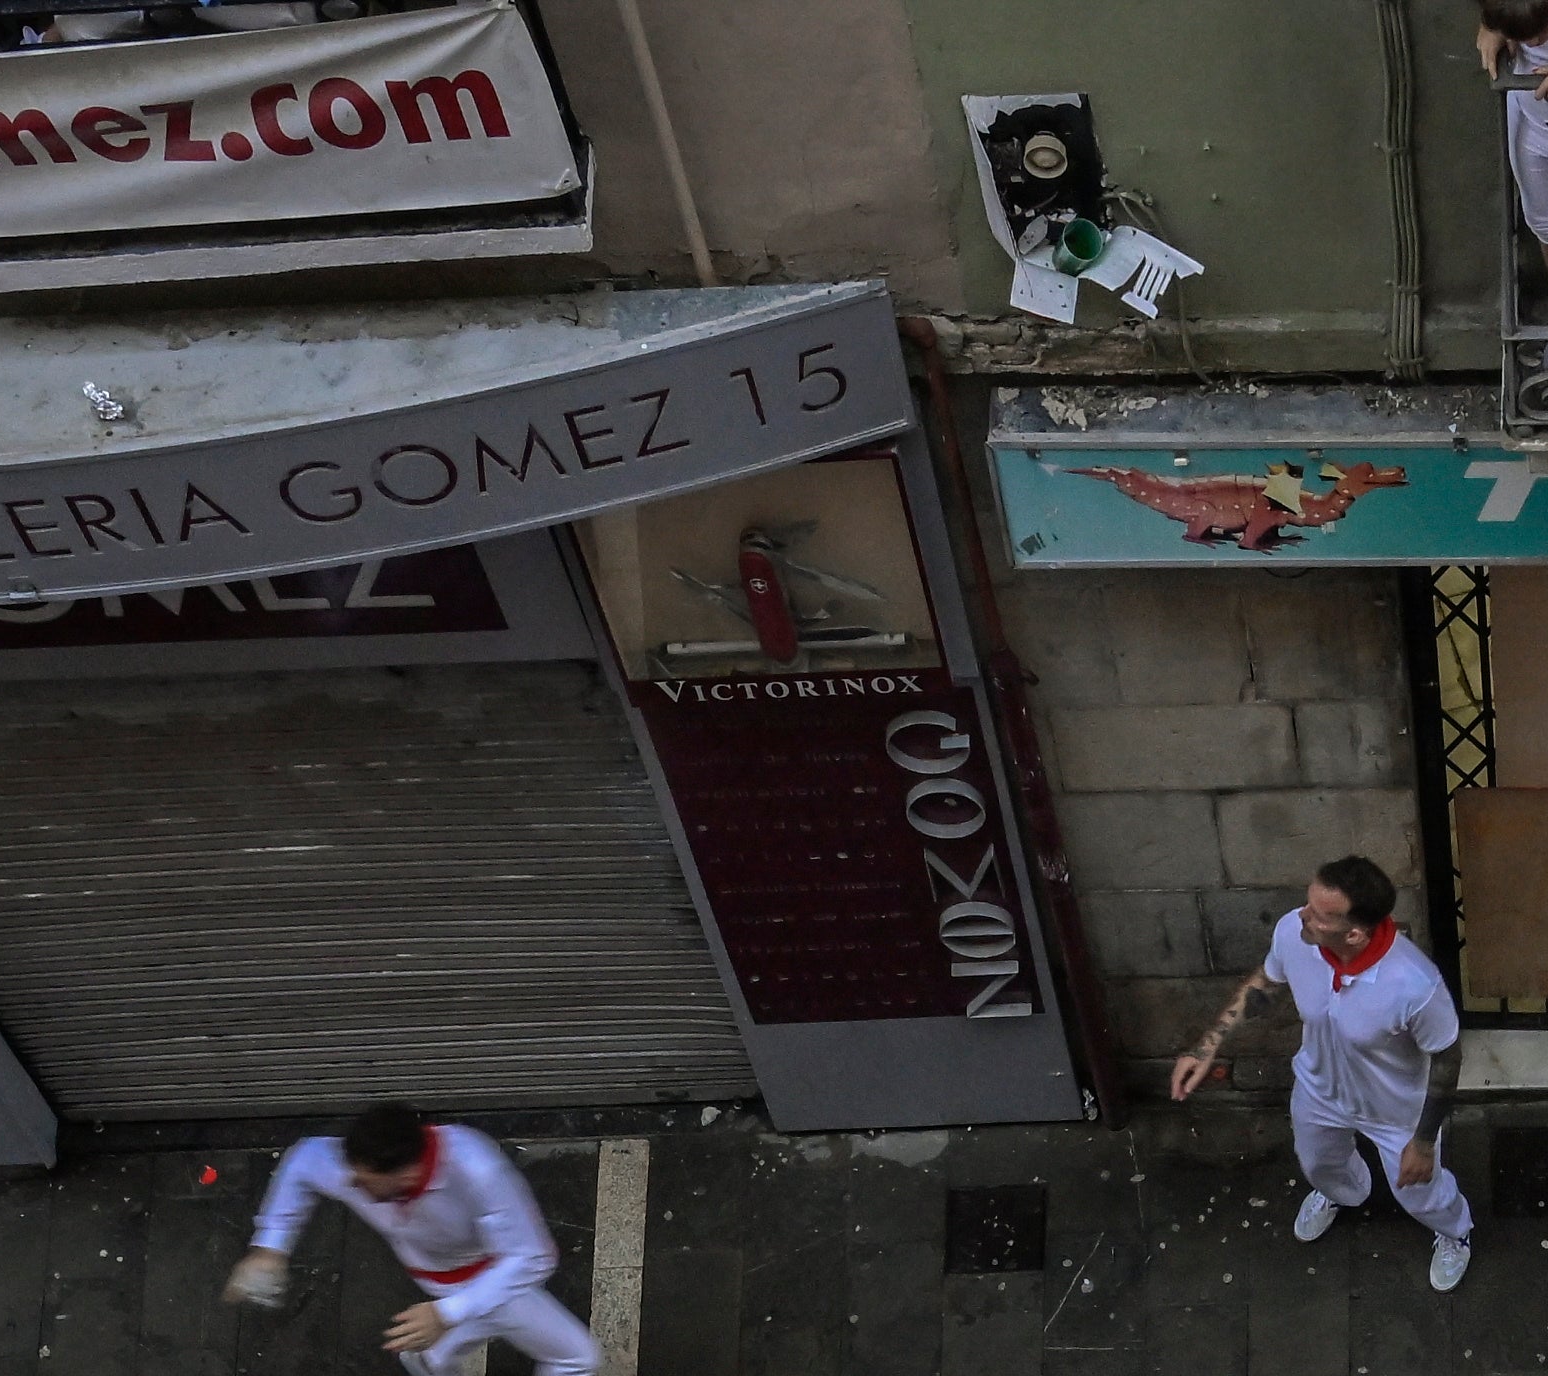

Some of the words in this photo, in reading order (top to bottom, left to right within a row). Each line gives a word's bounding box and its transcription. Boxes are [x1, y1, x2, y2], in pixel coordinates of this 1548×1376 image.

[277, 385, 692, 528] GOMEZ
[730, 340, 852, 428] 15
[654, 675, 924, 704] VICTORINOX
[886, 711, 1033, 1020] GOMEZ
